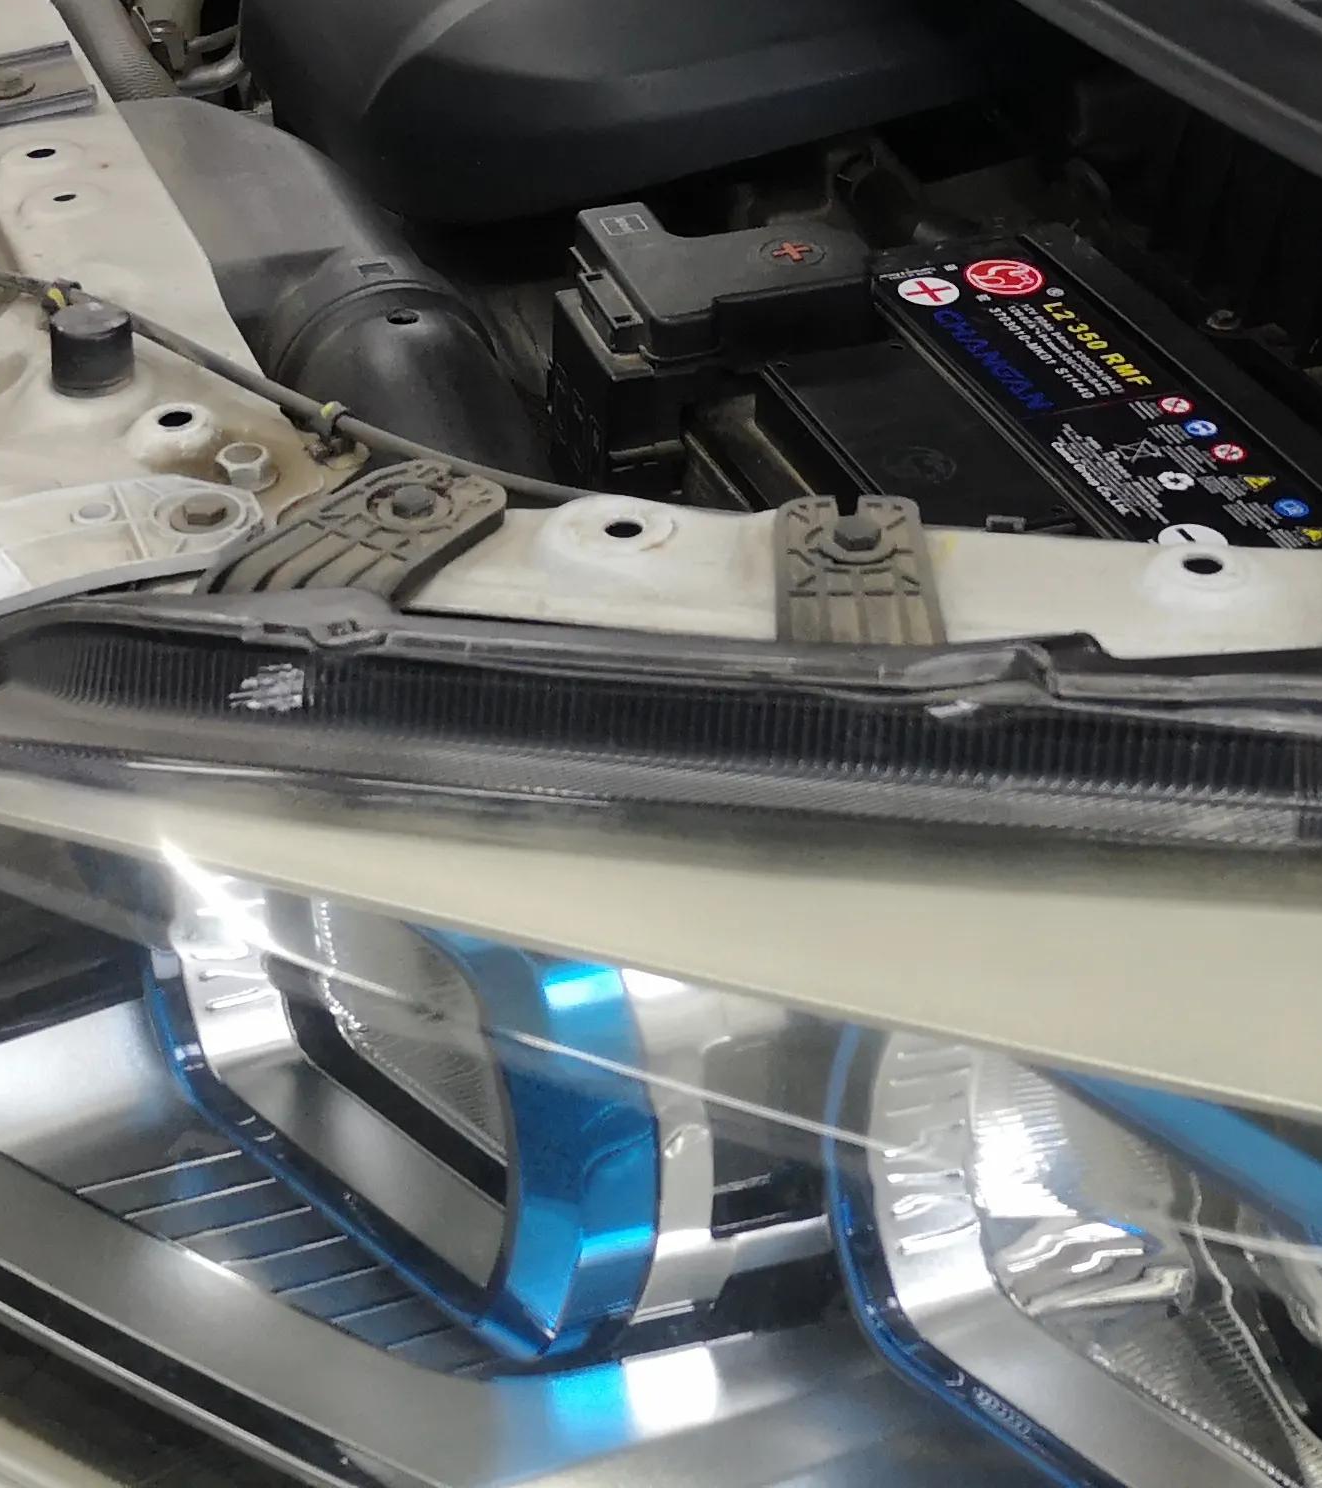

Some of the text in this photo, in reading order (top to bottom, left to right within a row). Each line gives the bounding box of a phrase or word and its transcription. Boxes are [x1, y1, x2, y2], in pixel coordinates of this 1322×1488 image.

[933, 306, 1054, 411] CHANGAN
[1067, 322, 1108, 350] 350
[1099, 352, 1153, 386] RMF
